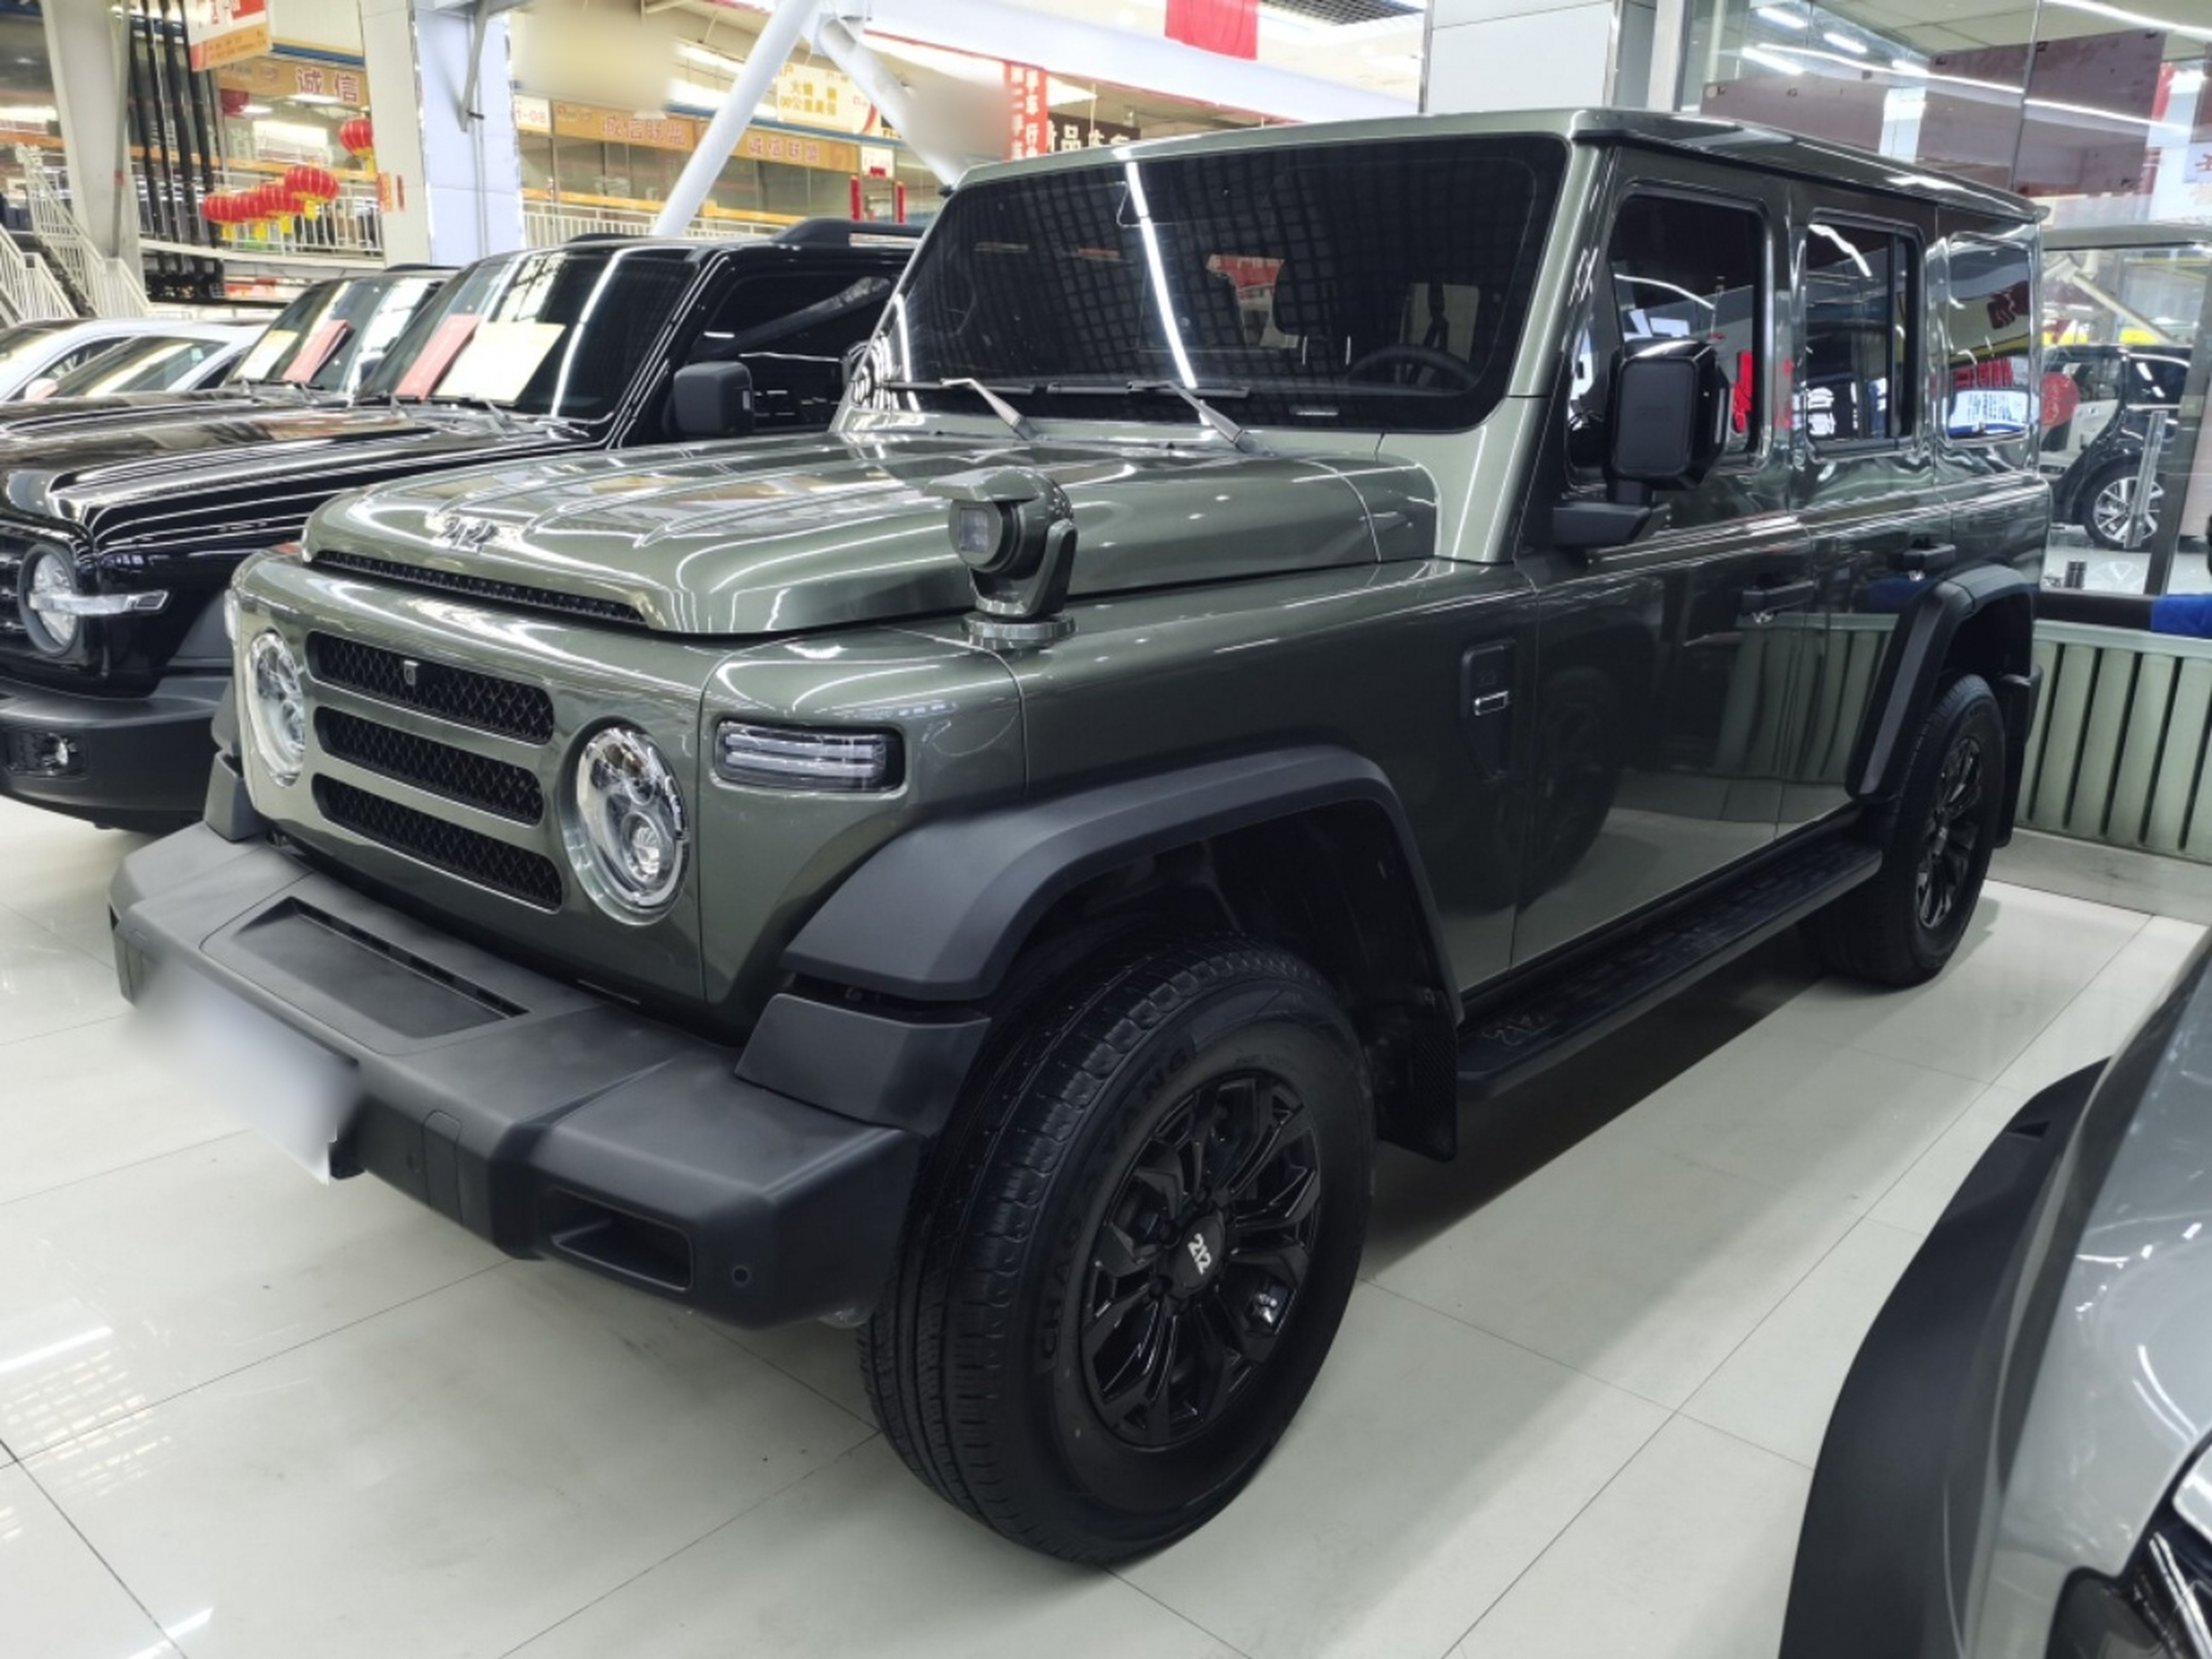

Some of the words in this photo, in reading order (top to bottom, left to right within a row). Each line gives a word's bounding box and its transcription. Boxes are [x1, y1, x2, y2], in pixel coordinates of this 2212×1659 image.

[296, 67, 359, 103] 诚信
[750, 138, 819, 162] 诚信联盟
[1188, 1233, 1211, 1275] 212
